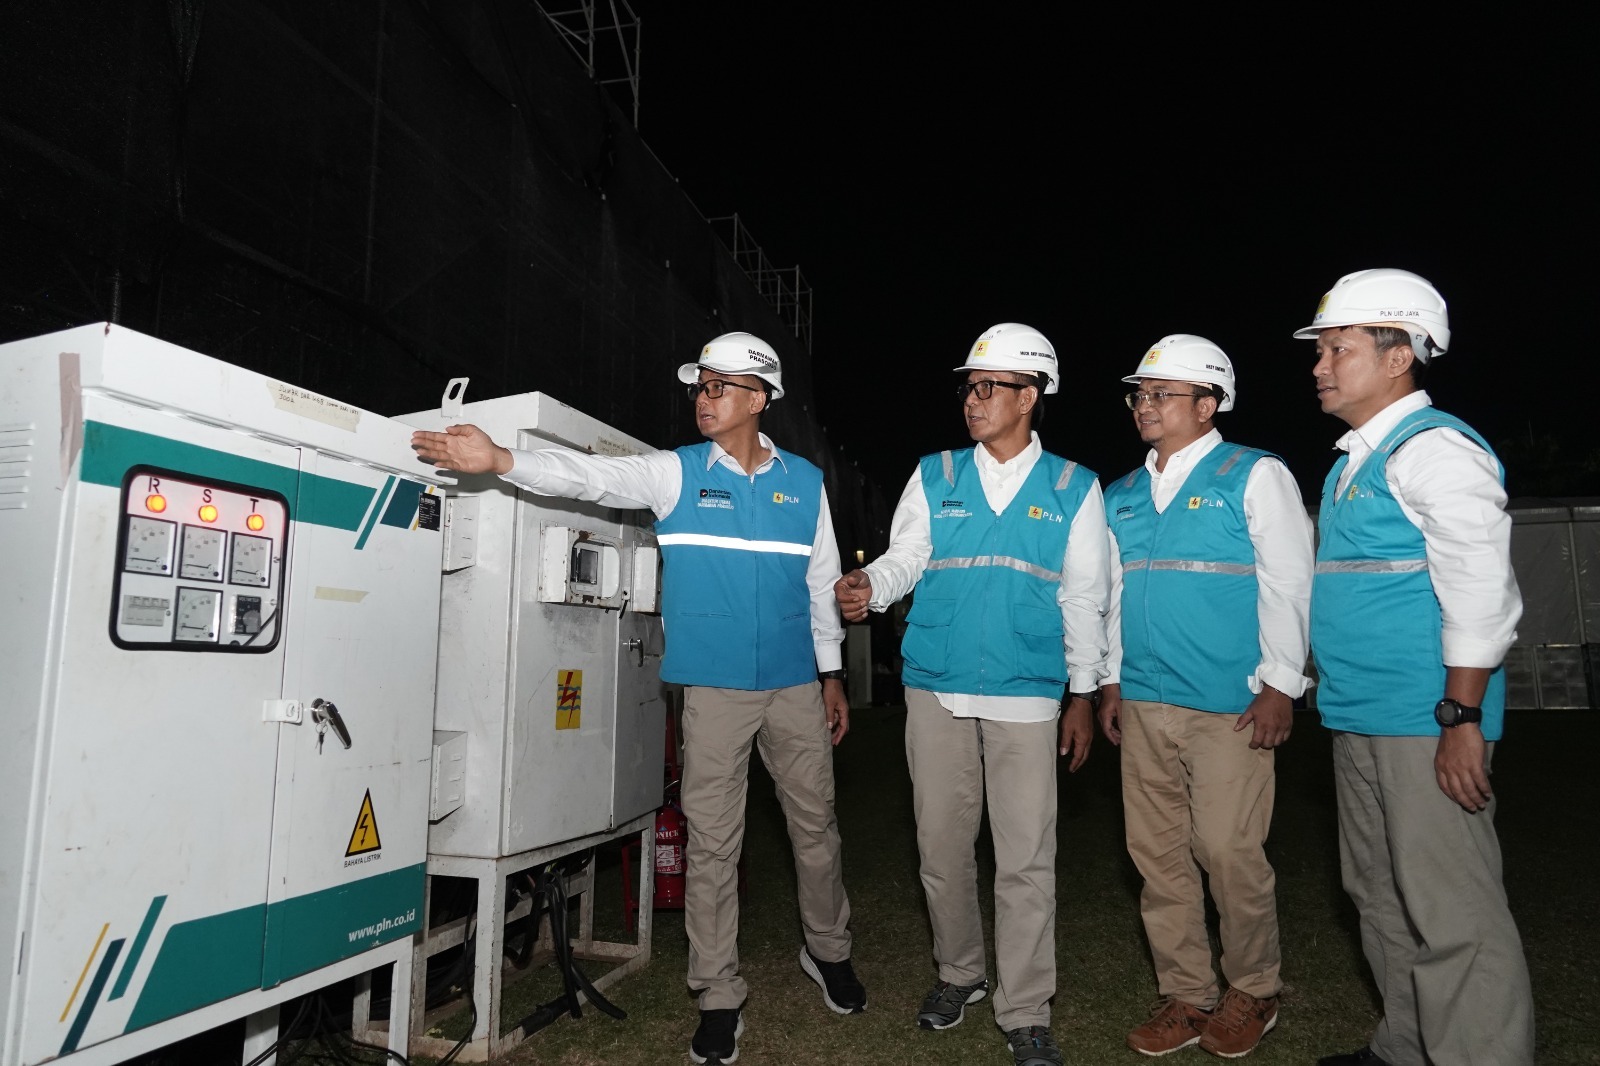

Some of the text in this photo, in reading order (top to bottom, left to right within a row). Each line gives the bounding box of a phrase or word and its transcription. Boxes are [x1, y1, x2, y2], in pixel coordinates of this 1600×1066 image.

[148, 477, 259, 513] R S T
[784, 494, 800, 504] PLN
[1201, 498, 1224, 508] PLN
[1042, 511, 1063, 523] PLN
[344, 852, 382, 868] BAHAYA LISTRIK
[348, 908, 416, 942] www.pln.co.id
